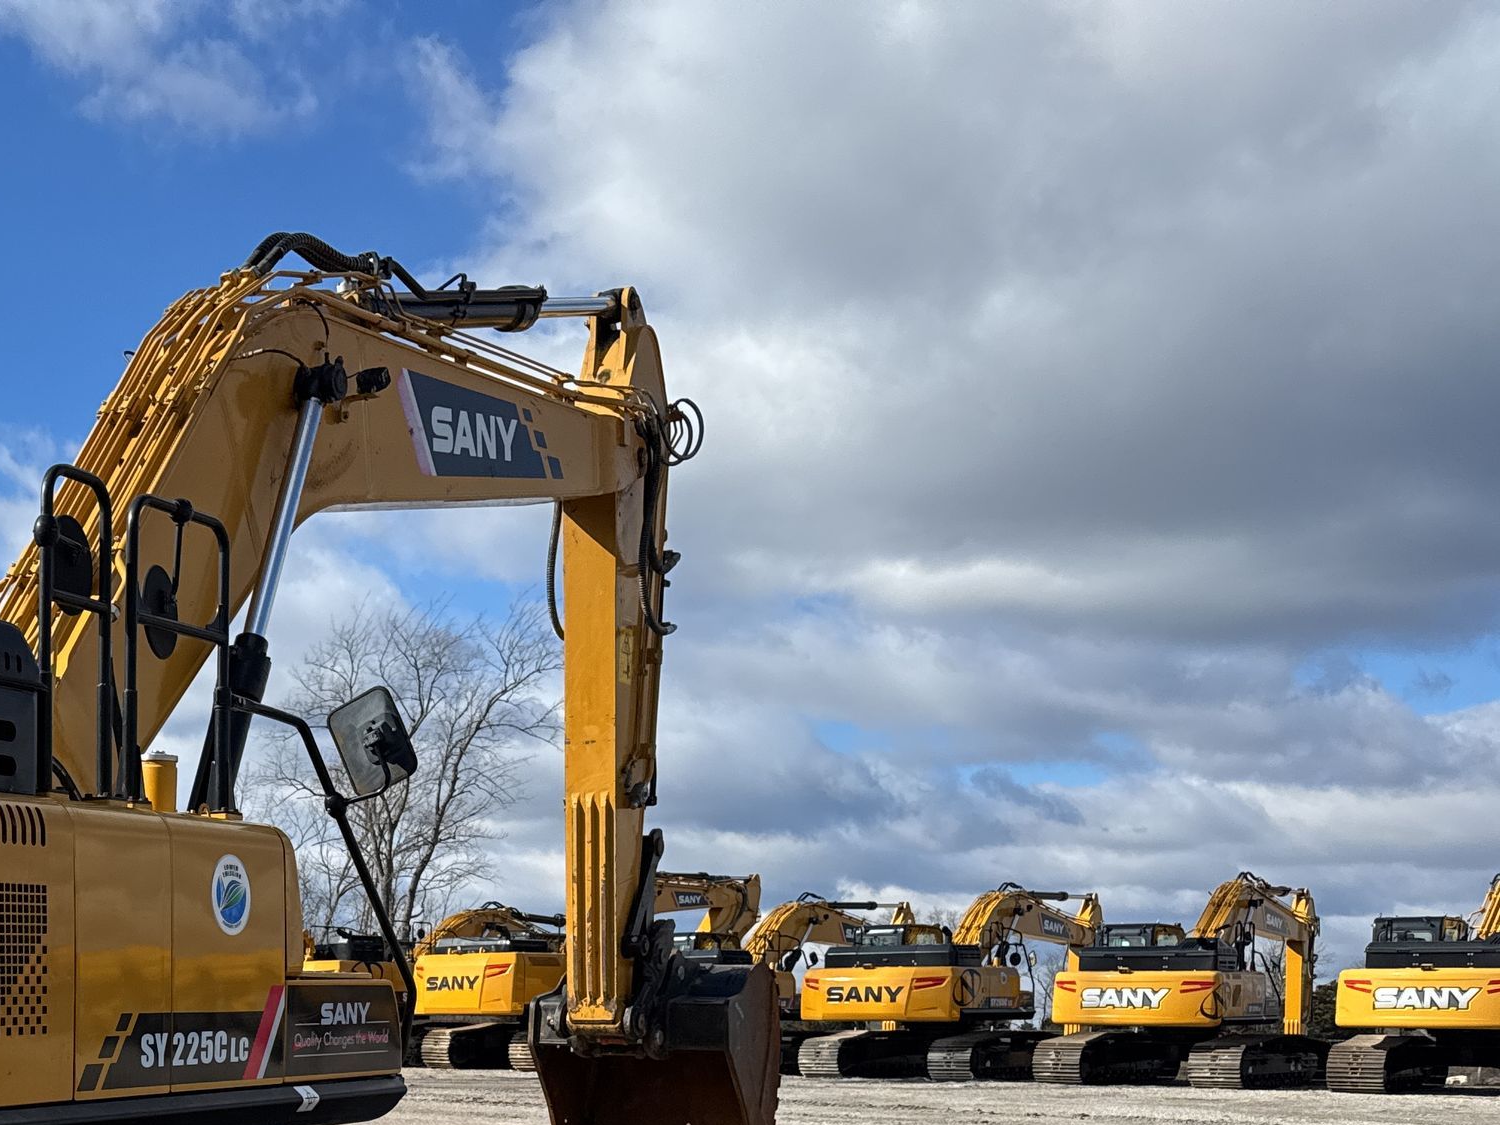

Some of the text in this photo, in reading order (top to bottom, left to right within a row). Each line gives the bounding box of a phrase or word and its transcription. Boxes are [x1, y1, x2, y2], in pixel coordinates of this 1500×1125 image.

[431, 406, 518, 461] SANY
[678, 895, 701, 904] SANY
[1043, 920, 1064, 934] SANY
[426, 976, 479, 992] SANY
[826, 986, 905, 1003] SANY
[1081, 987, 1171, 1009] SANY
[1373, 986, 1482, 1010] SANY
[320, 1002, 370, 1025] SANY
[294, 1027, 390, 1051] Quality Changes the World
